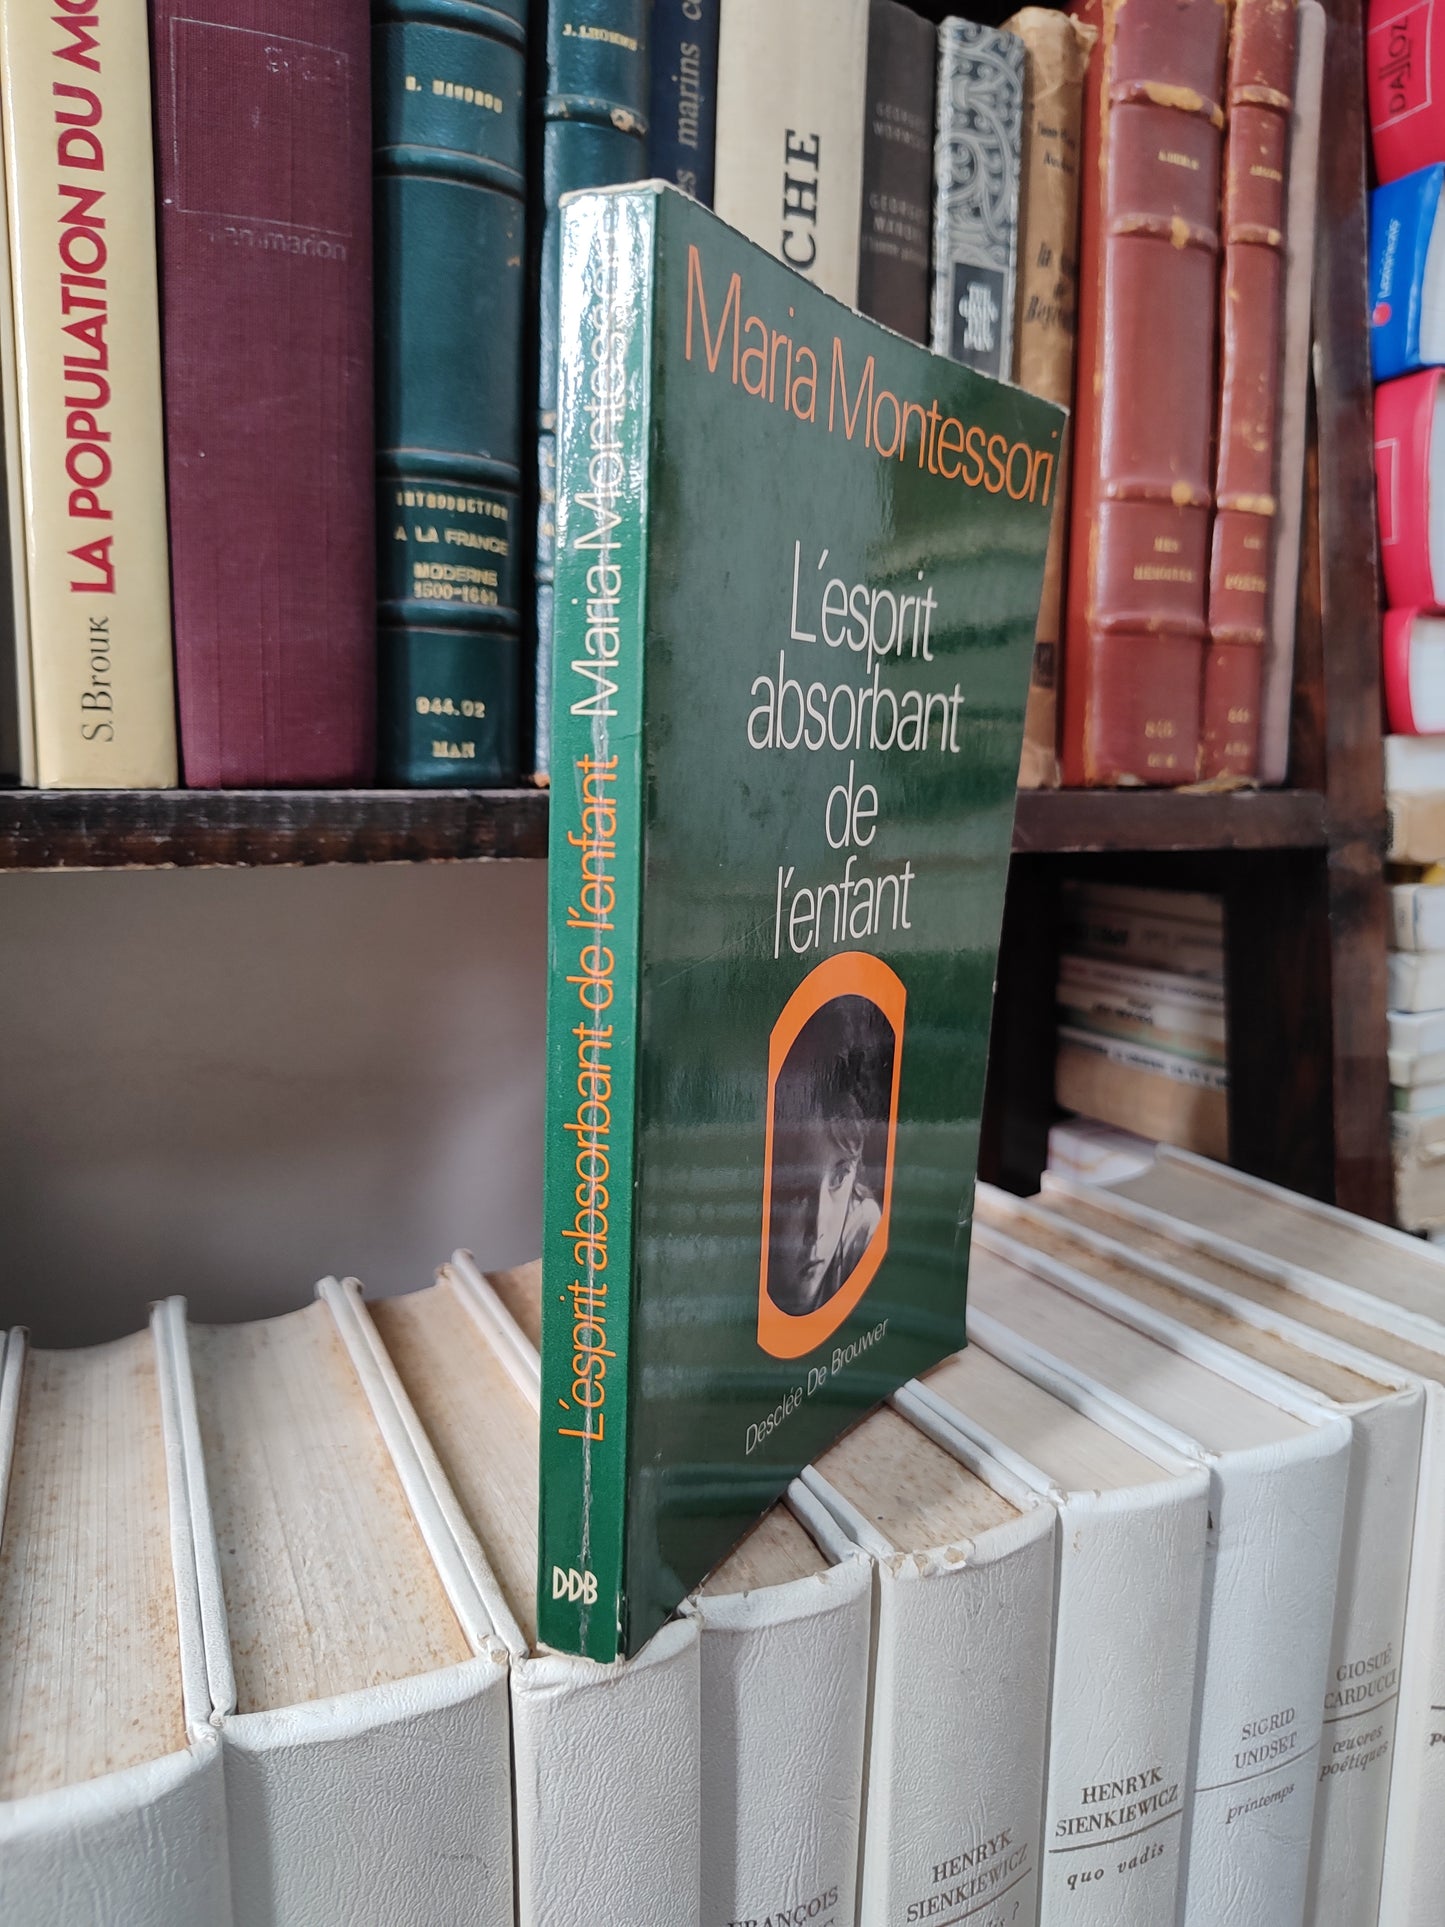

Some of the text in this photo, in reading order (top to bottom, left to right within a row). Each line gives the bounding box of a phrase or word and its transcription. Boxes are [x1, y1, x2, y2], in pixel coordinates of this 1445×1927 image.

[1379, 15, 1412, 114] DALLOZ
[671, 41, 702, 150] marins
[50, 0, 117, 594] LA POPULATION DU M
[684, 244, 817, 424] Maria
[828, 336, 1058, 506] Montessori
[414, 525, 439, 543] LA
[444, 527, 508, 556] FRANCE
[413, 561, 498, 587] MODERNE
[789, 539, 938, 674] L'esprit
[570, 560, 621, 717] Maria
[747, 649, 965, 753] absorbant
[432, 740, 475, 759] MAN
[824, 759, 879, 849] de
[774, 854, 916, 959] l'enfant
[559, 753, 618, 1441] L'esprit absorbant de l'enfant
[744, 1318, 889, 1456] Desclée De Brouwer
[552, 1565, 599, 1605] DDB
[1324, 1668, 1397, 1710] CARDUCCI
[1234, 1732, 1297, 1769] UNDSET
[1241, 1707, 1295, 1741] SIGRID
[1081, 1766, 1164, 1805] HENRYK
[1319, 1740, 1389, 1782] poétiques
[1055, 1783, 1179, 1837] SIENKIEWICZ
[1226, 1784, 1295, 1825] printemps
[906, 1843, 1028, 1923] SIENKIEWICZ
[932, 1828, 1013, 1883] HENRYK
[1067, 1843, 1164, 1891] quo vadis
